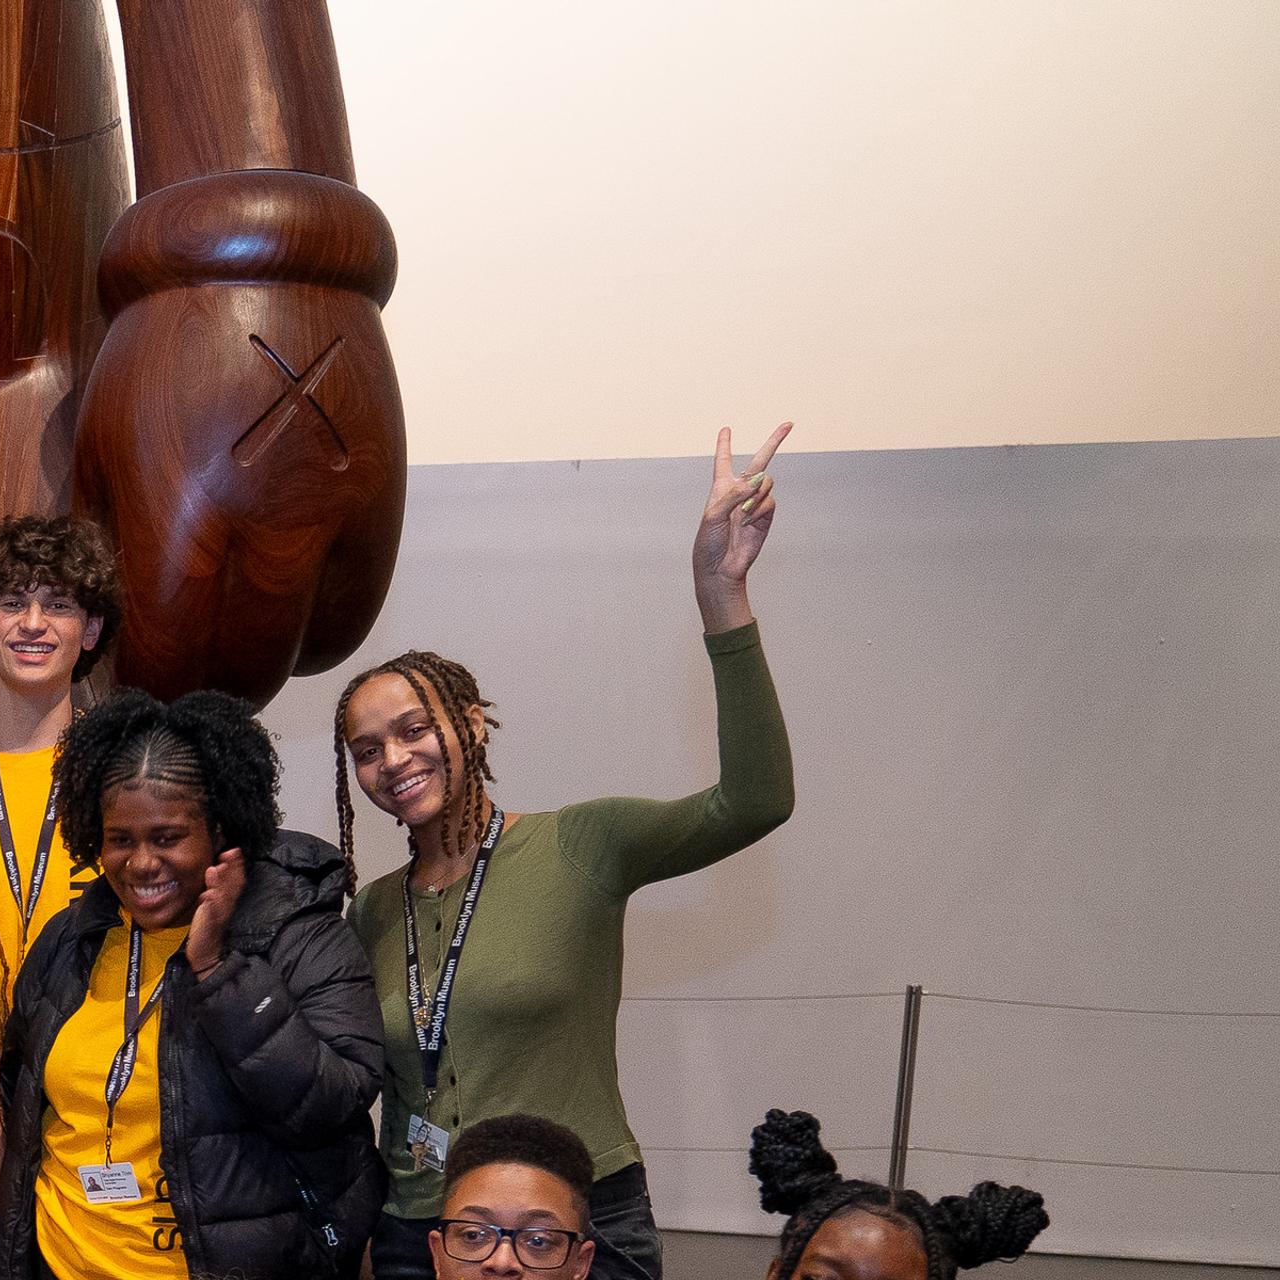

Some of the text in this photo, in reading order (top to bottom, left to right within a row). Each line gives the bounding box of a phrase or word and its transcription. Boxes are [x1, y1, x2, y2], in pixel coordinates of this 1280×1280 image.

[6, 851, 19, 890] Brooklyn
[32, 852, 46, 883] Museum
[452, 860, 485, 947] Brooklyn Museum
[128, 968, 138, 998] Brooklyn
[408, 964, 419, 1007] Brooklyn
[428, 959, 456, 1051] Brooklyn Museum
